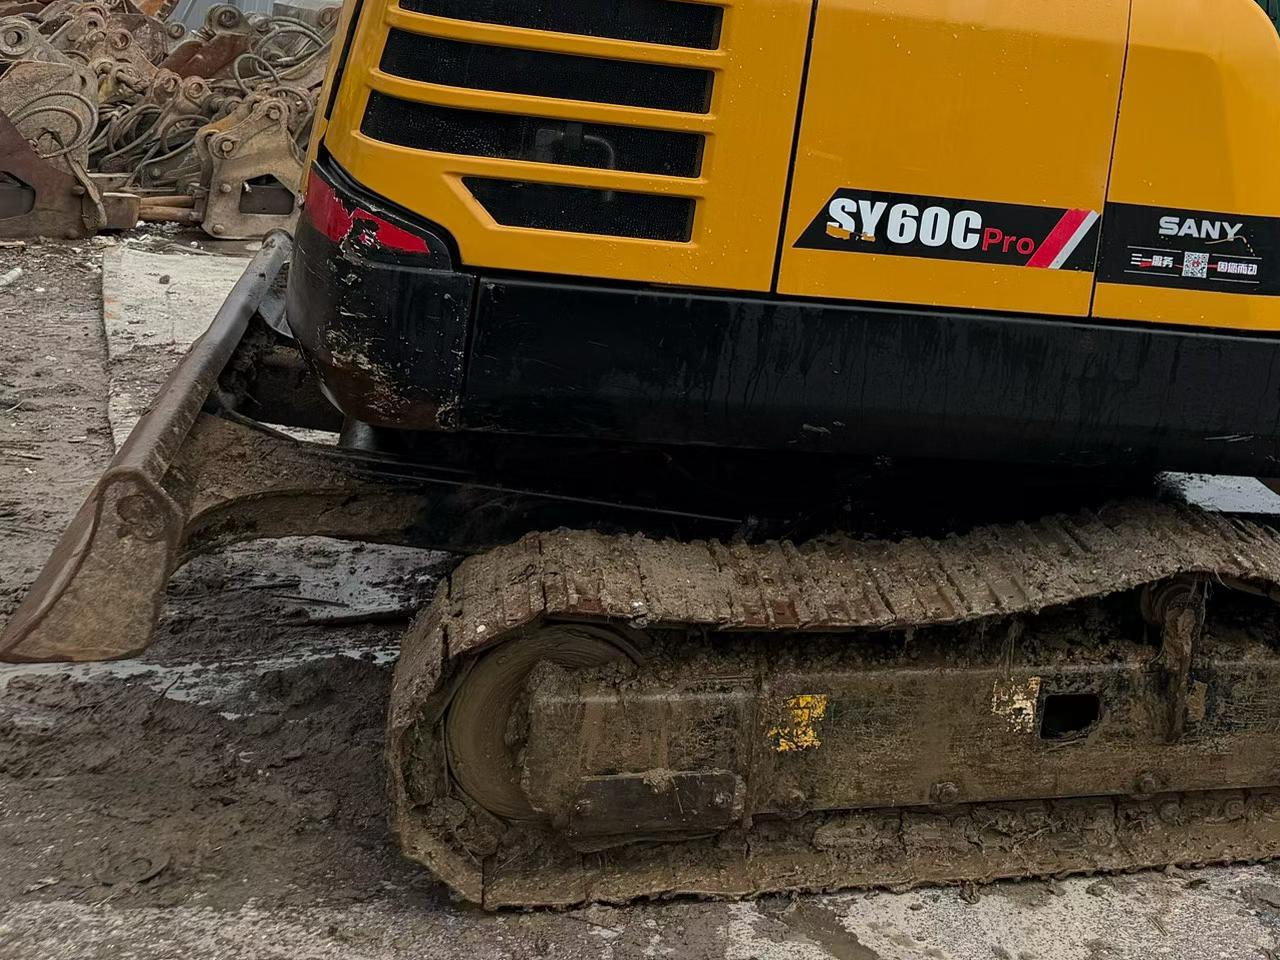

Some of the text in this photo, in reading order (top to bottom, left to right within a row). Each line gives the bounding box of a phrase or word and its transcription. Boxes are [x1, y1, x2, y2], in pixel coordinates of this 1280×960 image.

[826, 197, 1035, 256] SY60C Pro
[1158, 215, 1244, 242] SANY
[1130, 252, 1174, 269] 三一服务
